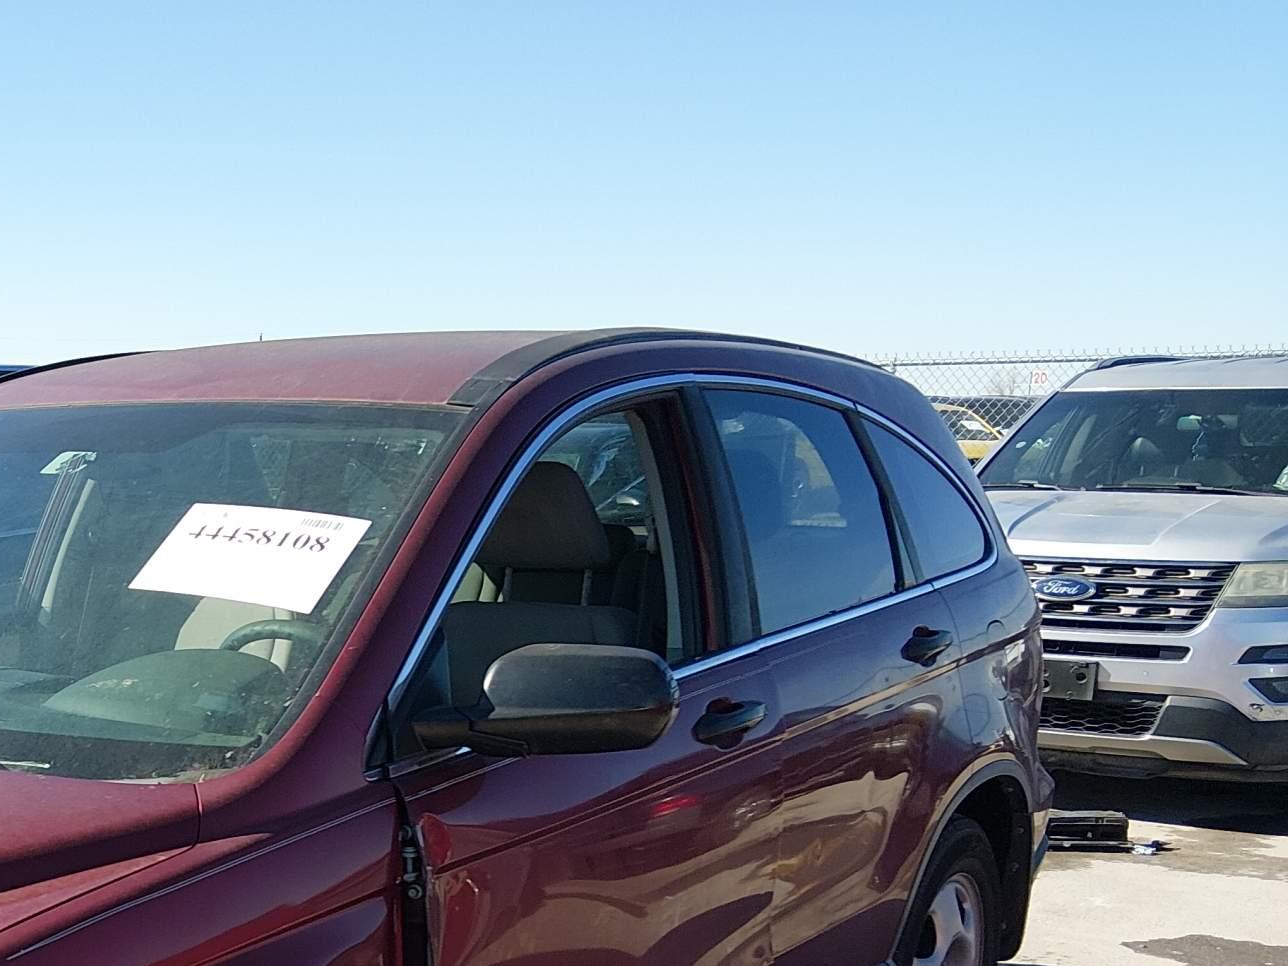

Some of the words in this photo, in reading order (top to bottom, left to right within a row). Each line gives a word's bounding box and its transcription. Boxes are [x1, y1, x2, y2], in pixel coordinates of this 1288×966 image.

[1033, 371, 1048, 385] 20
[188, 524, 331, 553] 44458108
[1043, 580, 1081, 595] Ford
